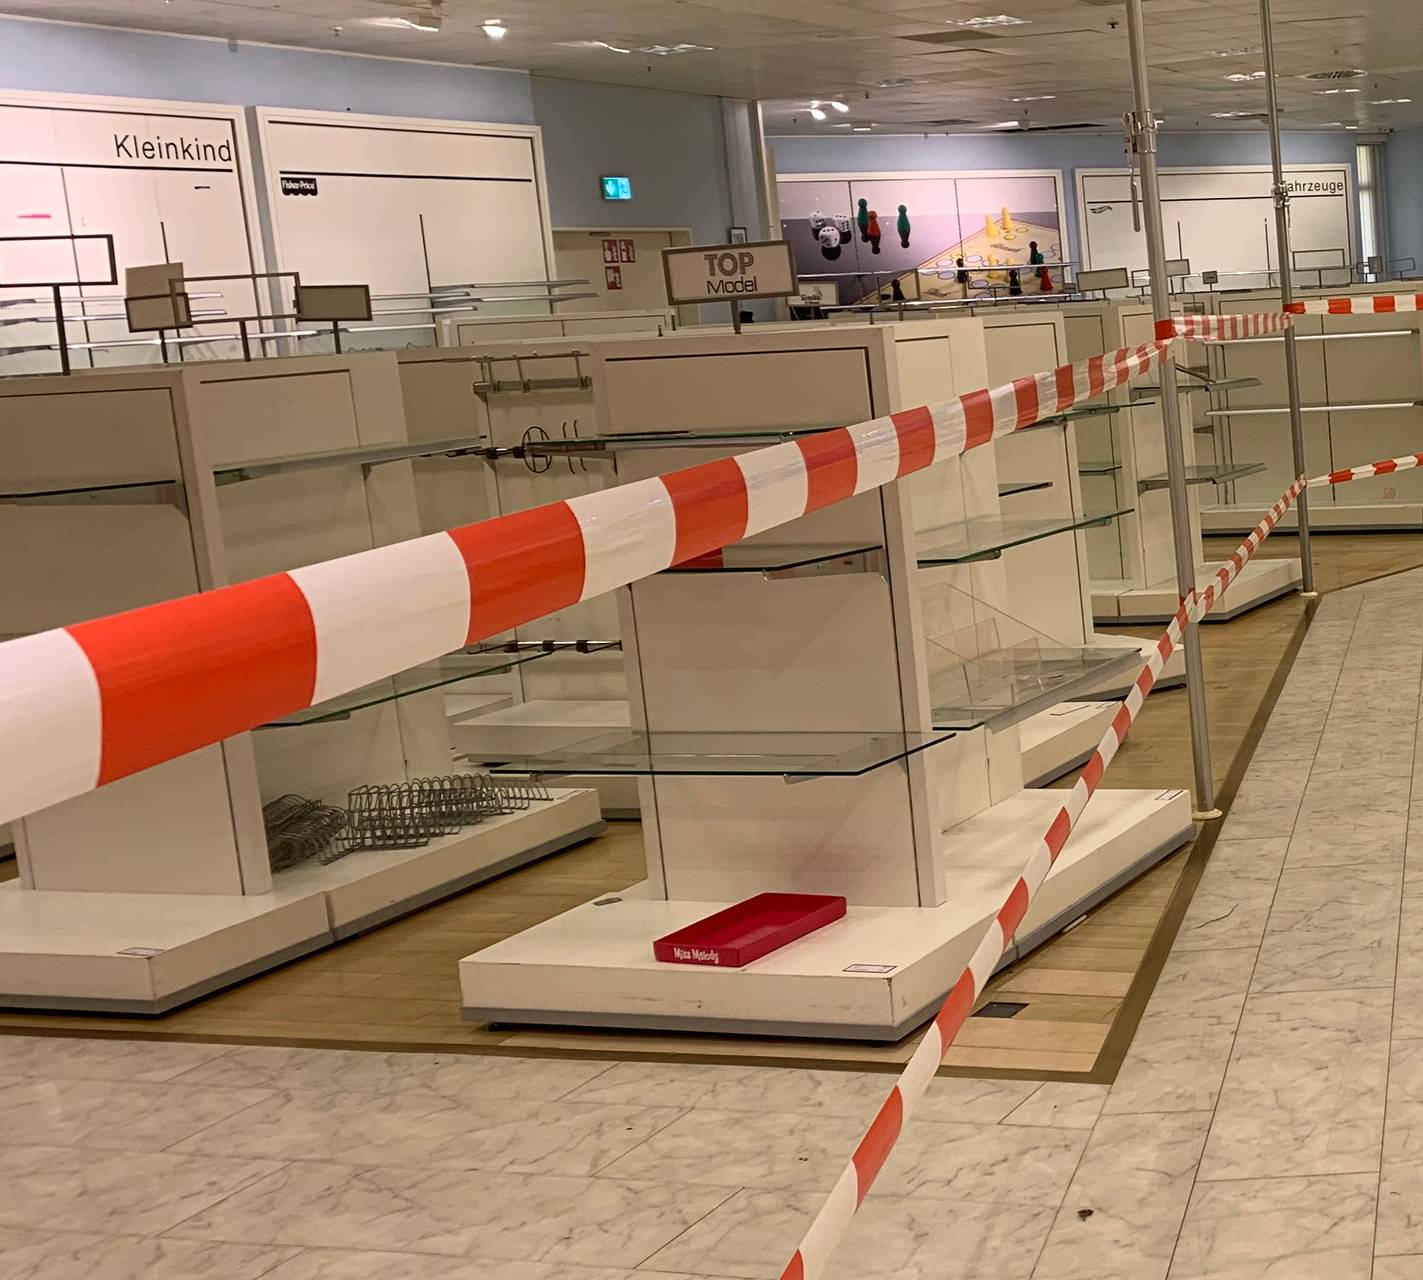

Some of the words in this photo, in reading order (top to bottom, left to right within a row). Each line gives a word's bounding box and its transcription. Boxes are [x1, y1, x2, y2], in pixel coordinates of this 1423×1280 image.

[114, 134, 232, 161] Kleinkind
[703, 252, 754, 277] TOP
[706, 275, 758, 295] Model
